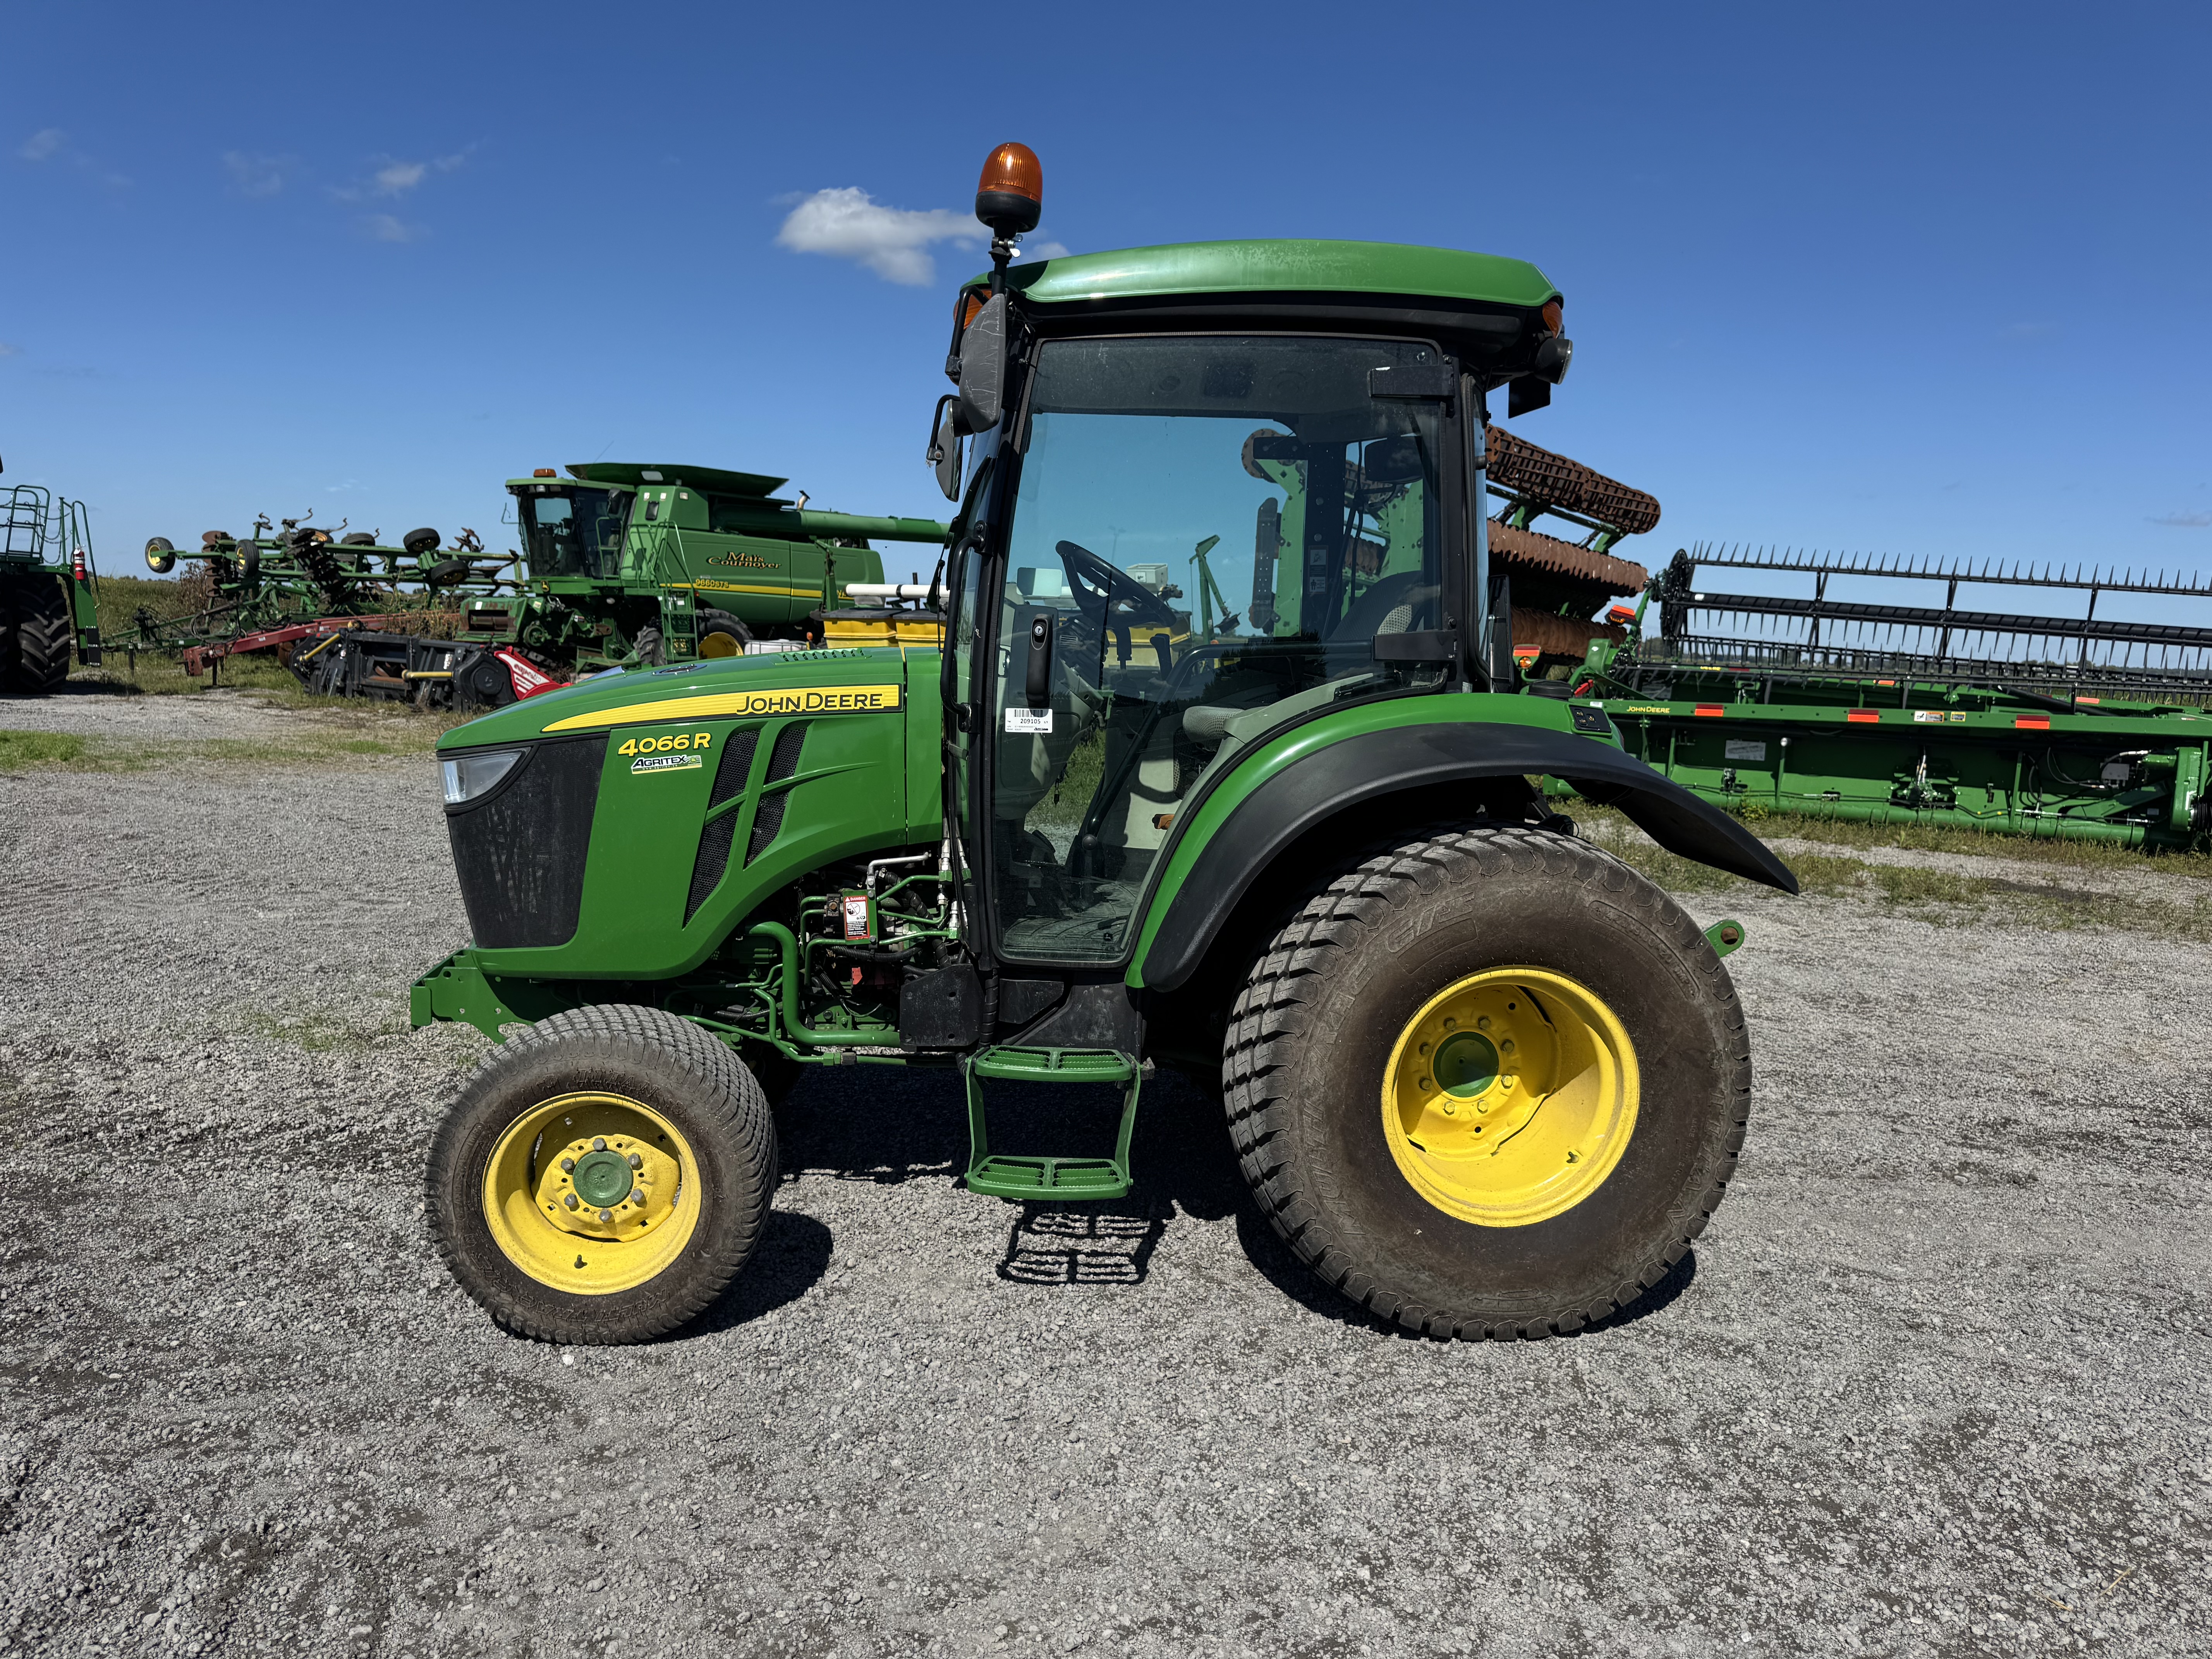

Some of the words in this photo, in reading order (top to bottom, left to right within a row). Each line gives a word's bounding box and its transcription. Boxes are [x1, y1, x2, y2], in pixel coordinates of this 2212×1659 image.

[706, 556, 781, 569] Cournoyer
[737, 696, 800, 713] JOHN
[805, 693, 883, 710] DEERE
[618, 735, 690, 756] 4066
[693, 733, 711, 749] R
[633, 756, 686, 768] AGRITEX
